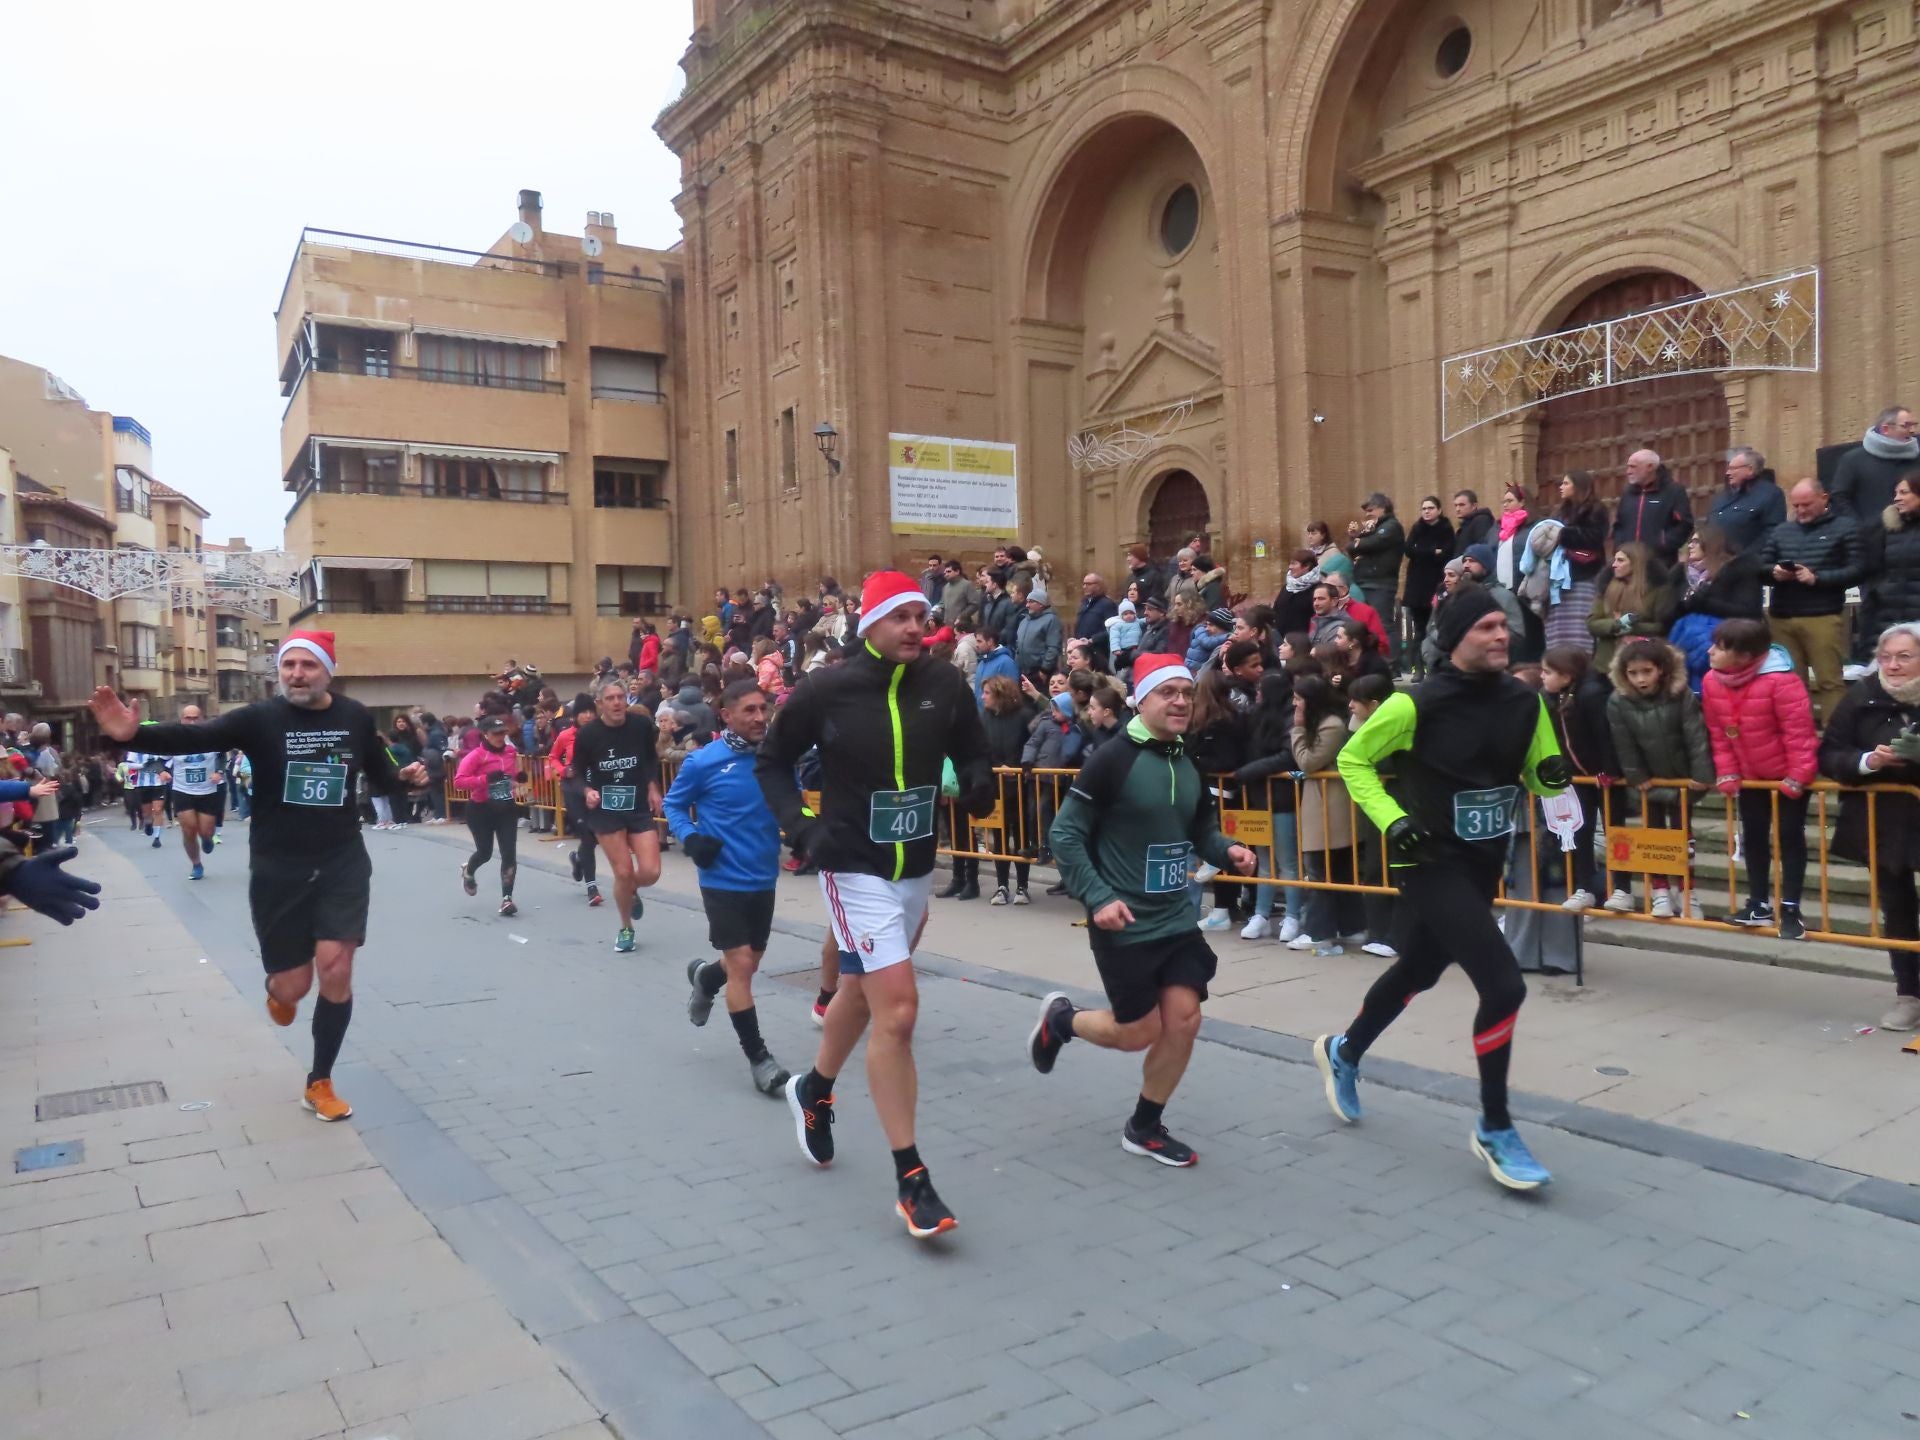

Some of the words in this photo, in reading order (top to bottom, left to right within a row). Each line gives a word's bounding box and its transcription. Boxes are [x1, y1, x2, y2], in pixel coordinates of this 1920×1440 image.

[307, 735, 342, 743] Educación
[189, 773, 203, 782] 151
[302, 779, 329, 801] 56
[611, 795, 626, 808] 37
[890, 810, 918, 836] 40
[1467, 806, 1504, 834] 319
[1636, 843, 1683, 854] AYUNTAMIENTO
[1642, 852, 1651, 860] DE
[1652, 853, 1676, 862] ALFARO
[1159, 861, 1186, 887] 185
